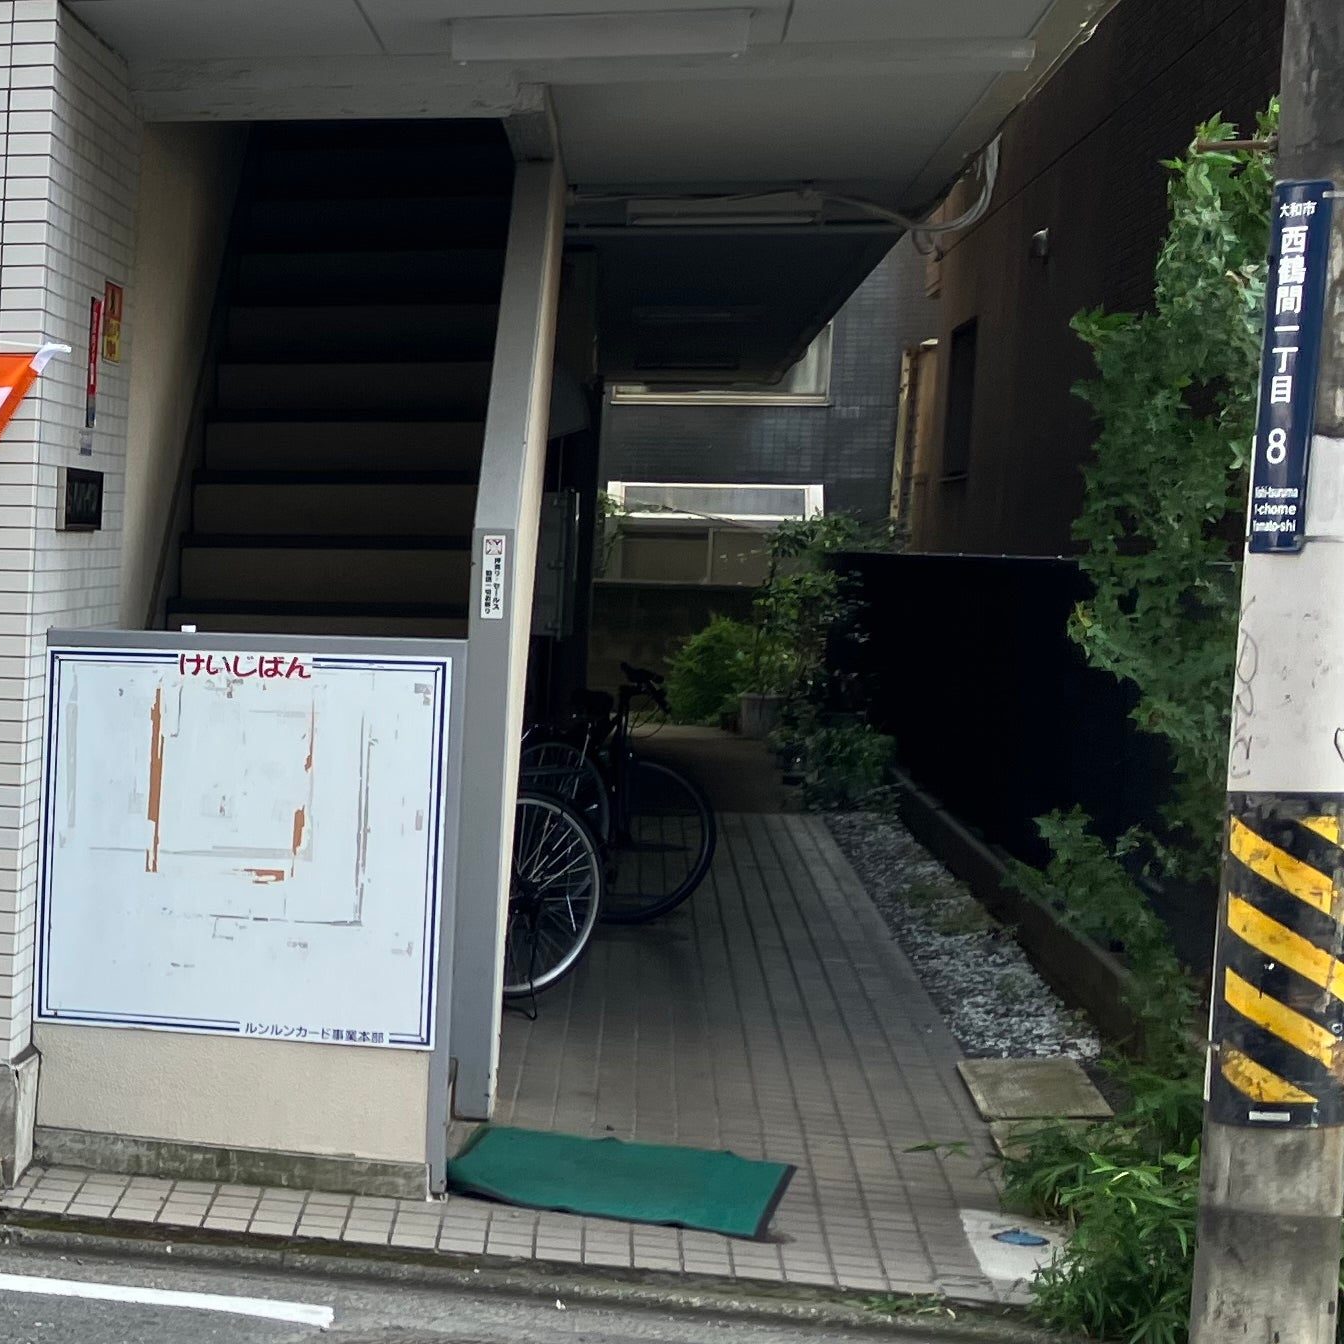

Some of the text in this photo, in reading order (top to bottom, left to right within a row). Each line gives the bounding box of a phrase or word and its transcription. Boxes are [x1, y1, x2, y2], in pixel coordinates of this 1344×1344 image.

[1279, 201, 1316, 217] 大和市
[1270, 225, 1309, 404] 西鶴間一丁目
[1266, 428, 1287, 464] 8
[179, 653, 312, 680] けいじばん
[245, 1022, 384, 1044] ルンルンカード事業本部
